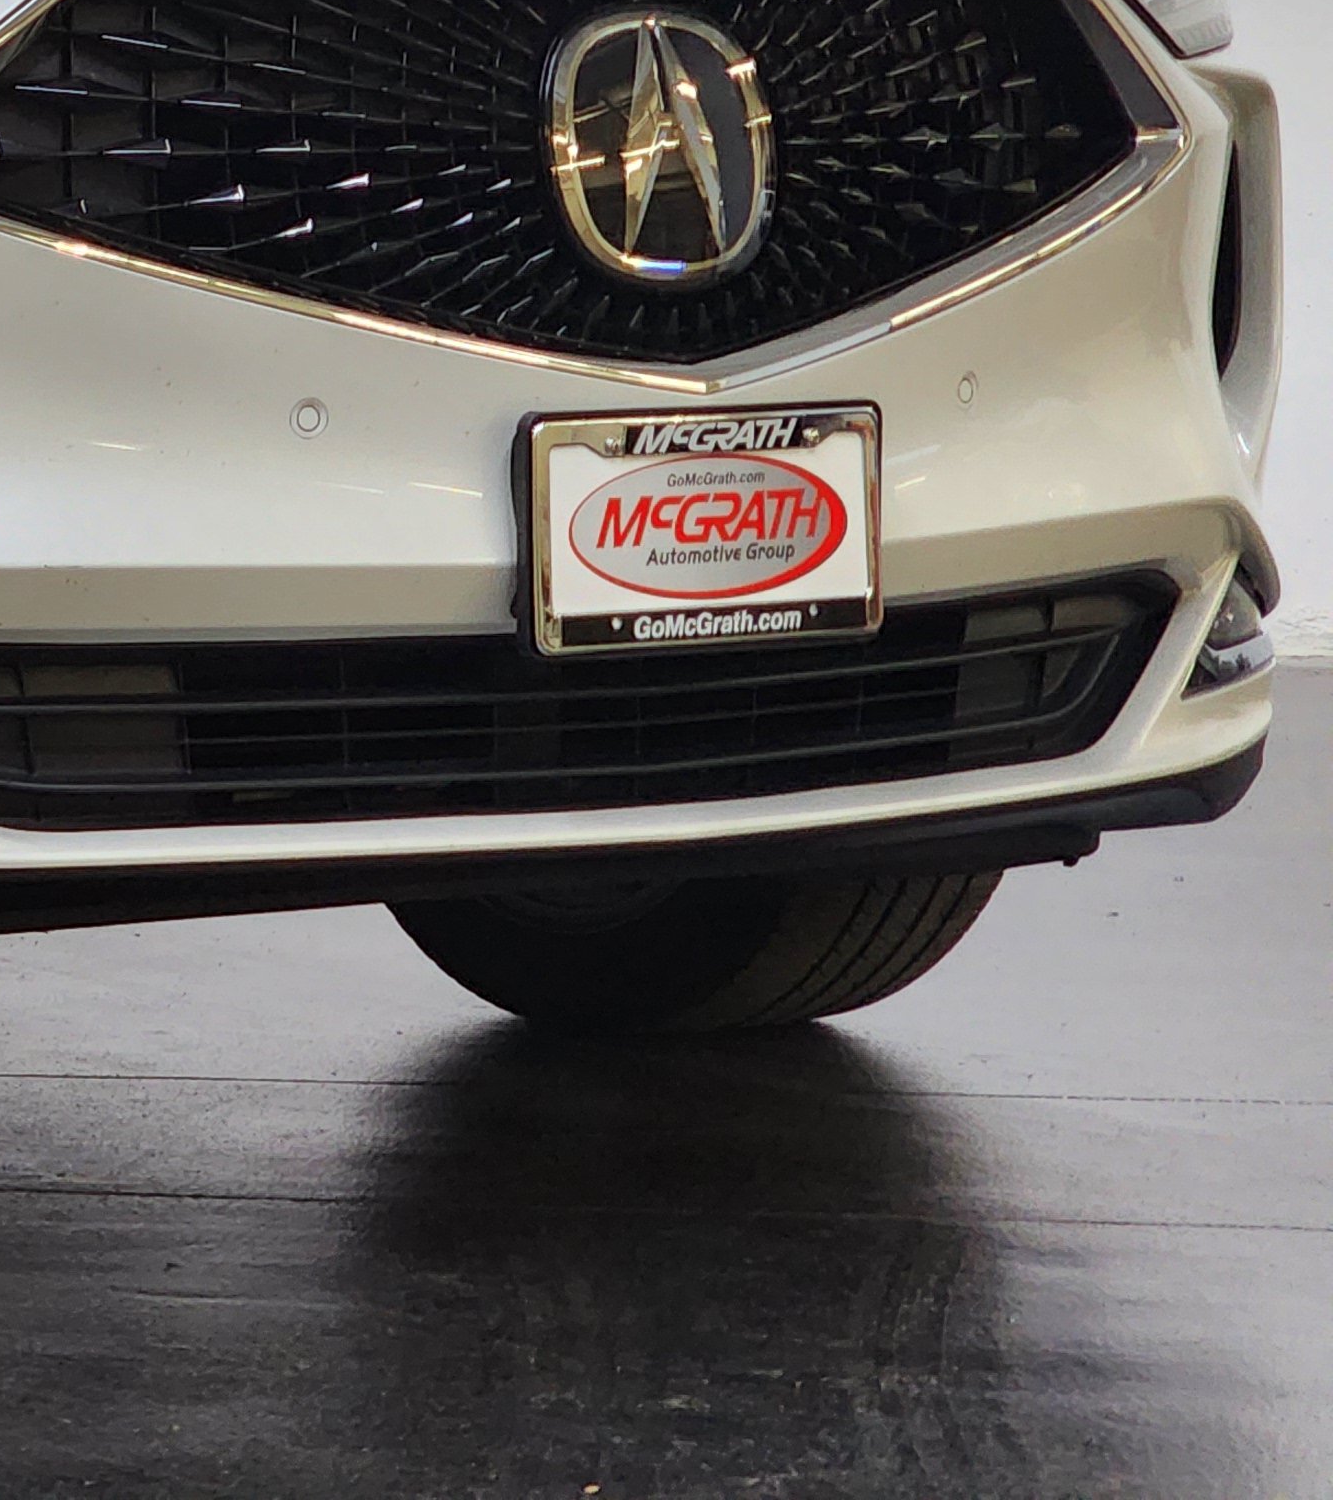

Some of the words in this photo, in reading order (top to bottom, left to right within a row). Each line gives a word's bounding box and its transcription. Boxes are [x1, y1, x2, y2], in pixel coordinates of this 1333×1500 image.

[667, 471, 766, 487] GoMcGrath.com
[646, 545, 741, 566] Automotive
[746, 542, 795, 563] Group
[634, 609, 801, 639] GoMcGrath.com
